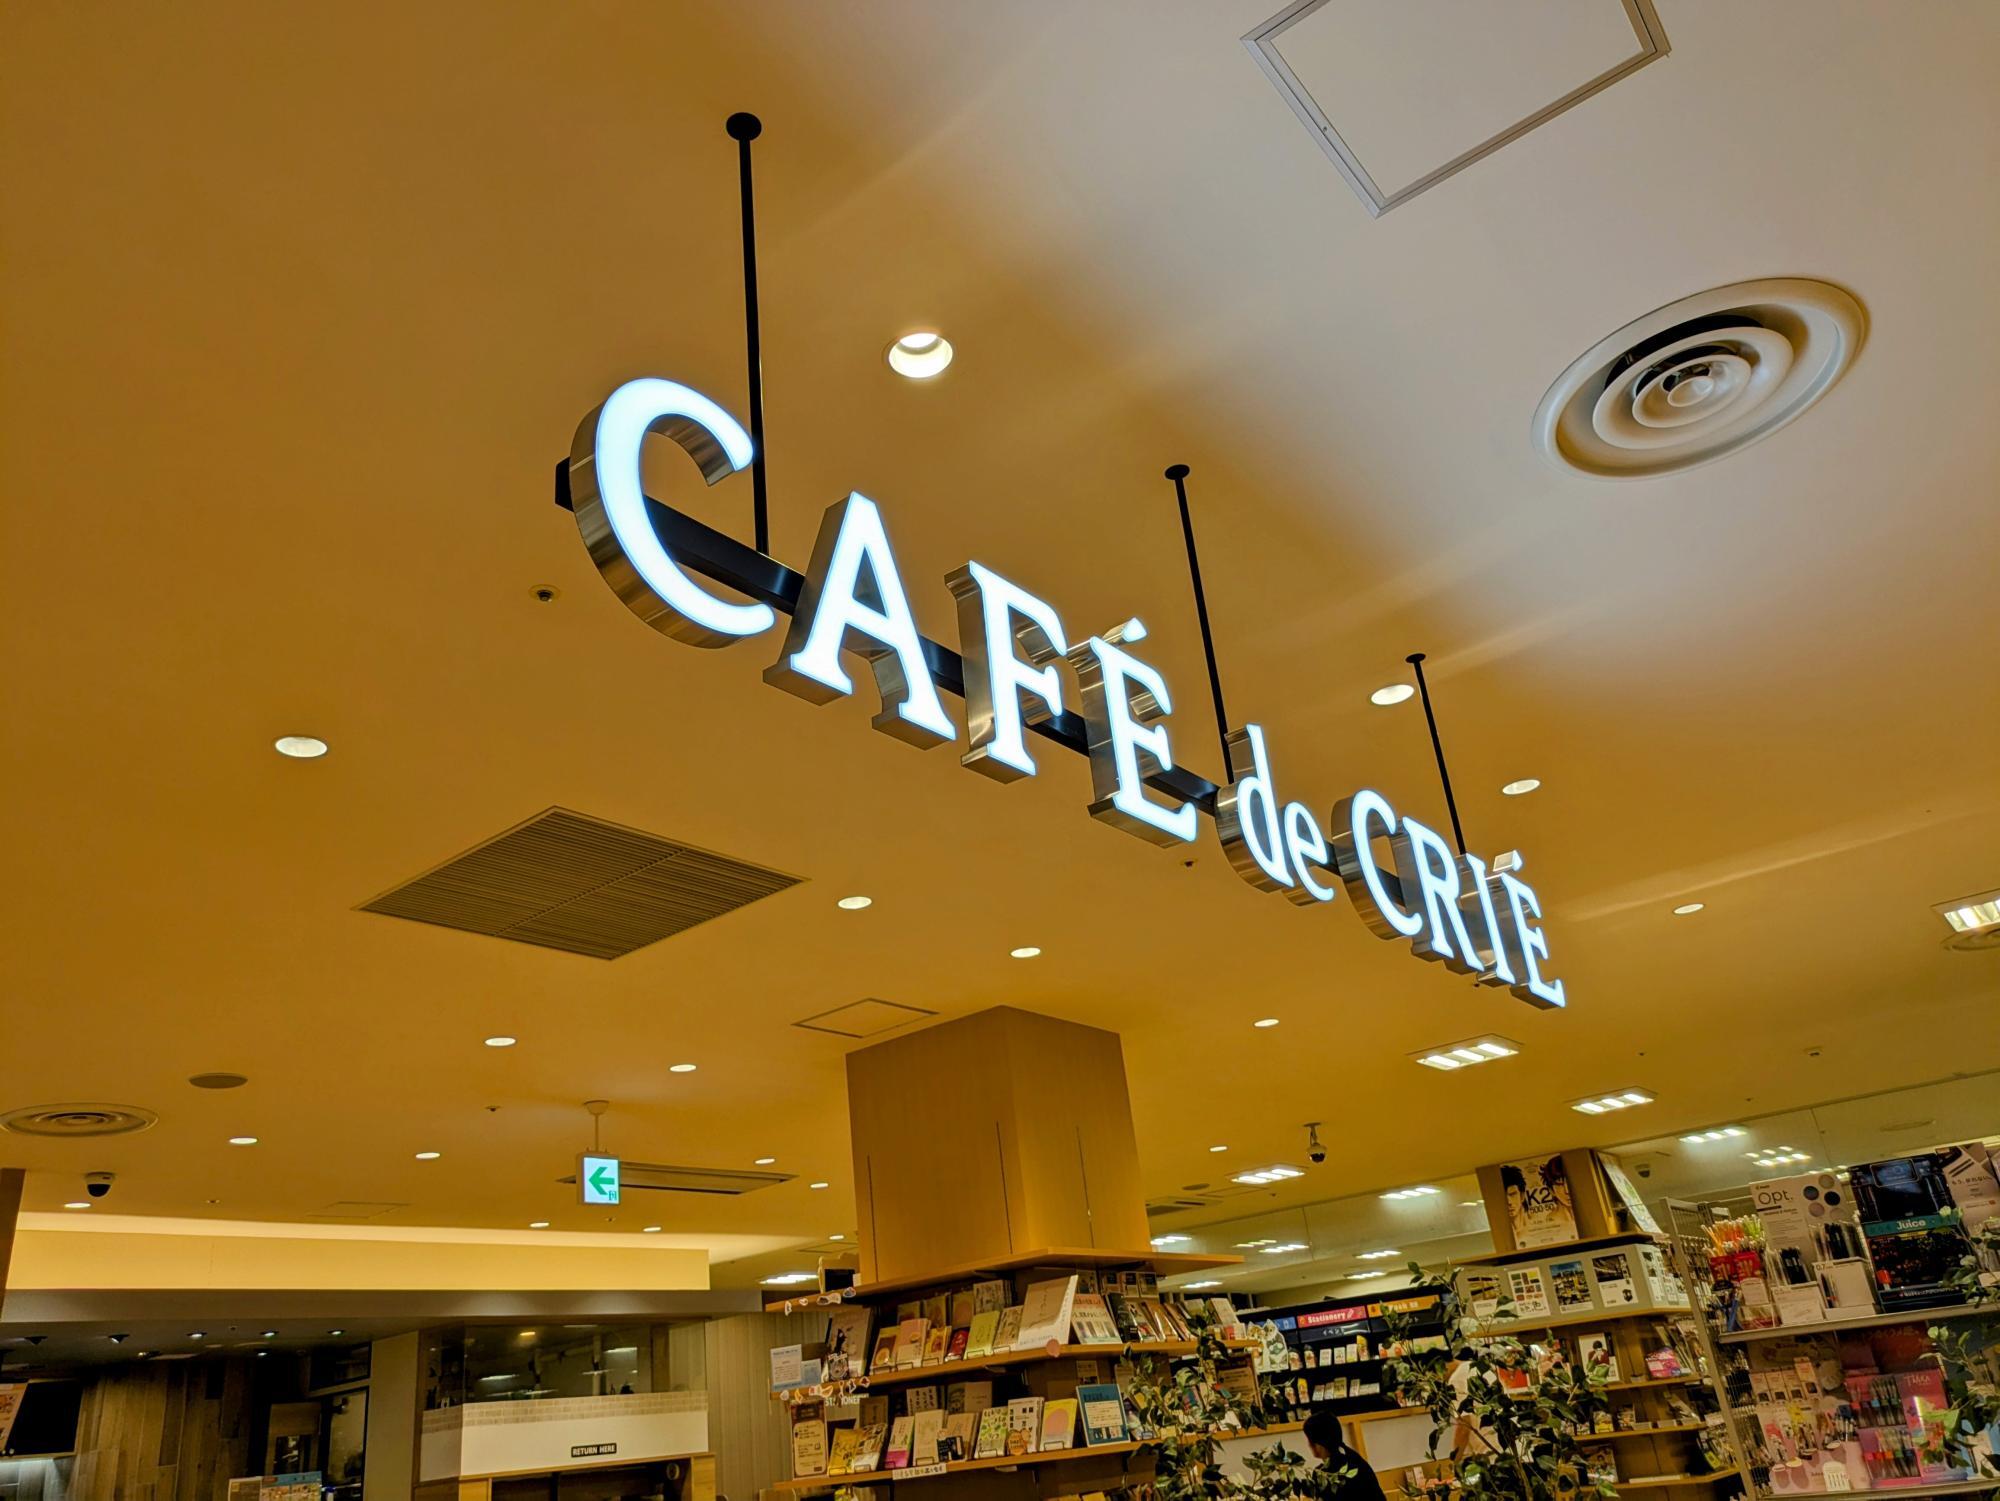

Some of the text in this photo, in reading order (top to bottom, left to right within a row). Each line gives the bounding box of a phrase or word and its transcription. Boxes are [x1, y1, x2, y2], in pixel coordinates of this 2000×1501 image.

[593, 377, 1566, 1008] CAFÉ de CRIÉ
[1525, 1186, 1555, 1206] K2
[1758, 1189, 1793, 1205] Opt.
[1896, 1218, 1927, 1231] Juice
[1307, 1311, 1346, 1324] Stationery
[572, 1444, 616, 1456] RETURN HERE
